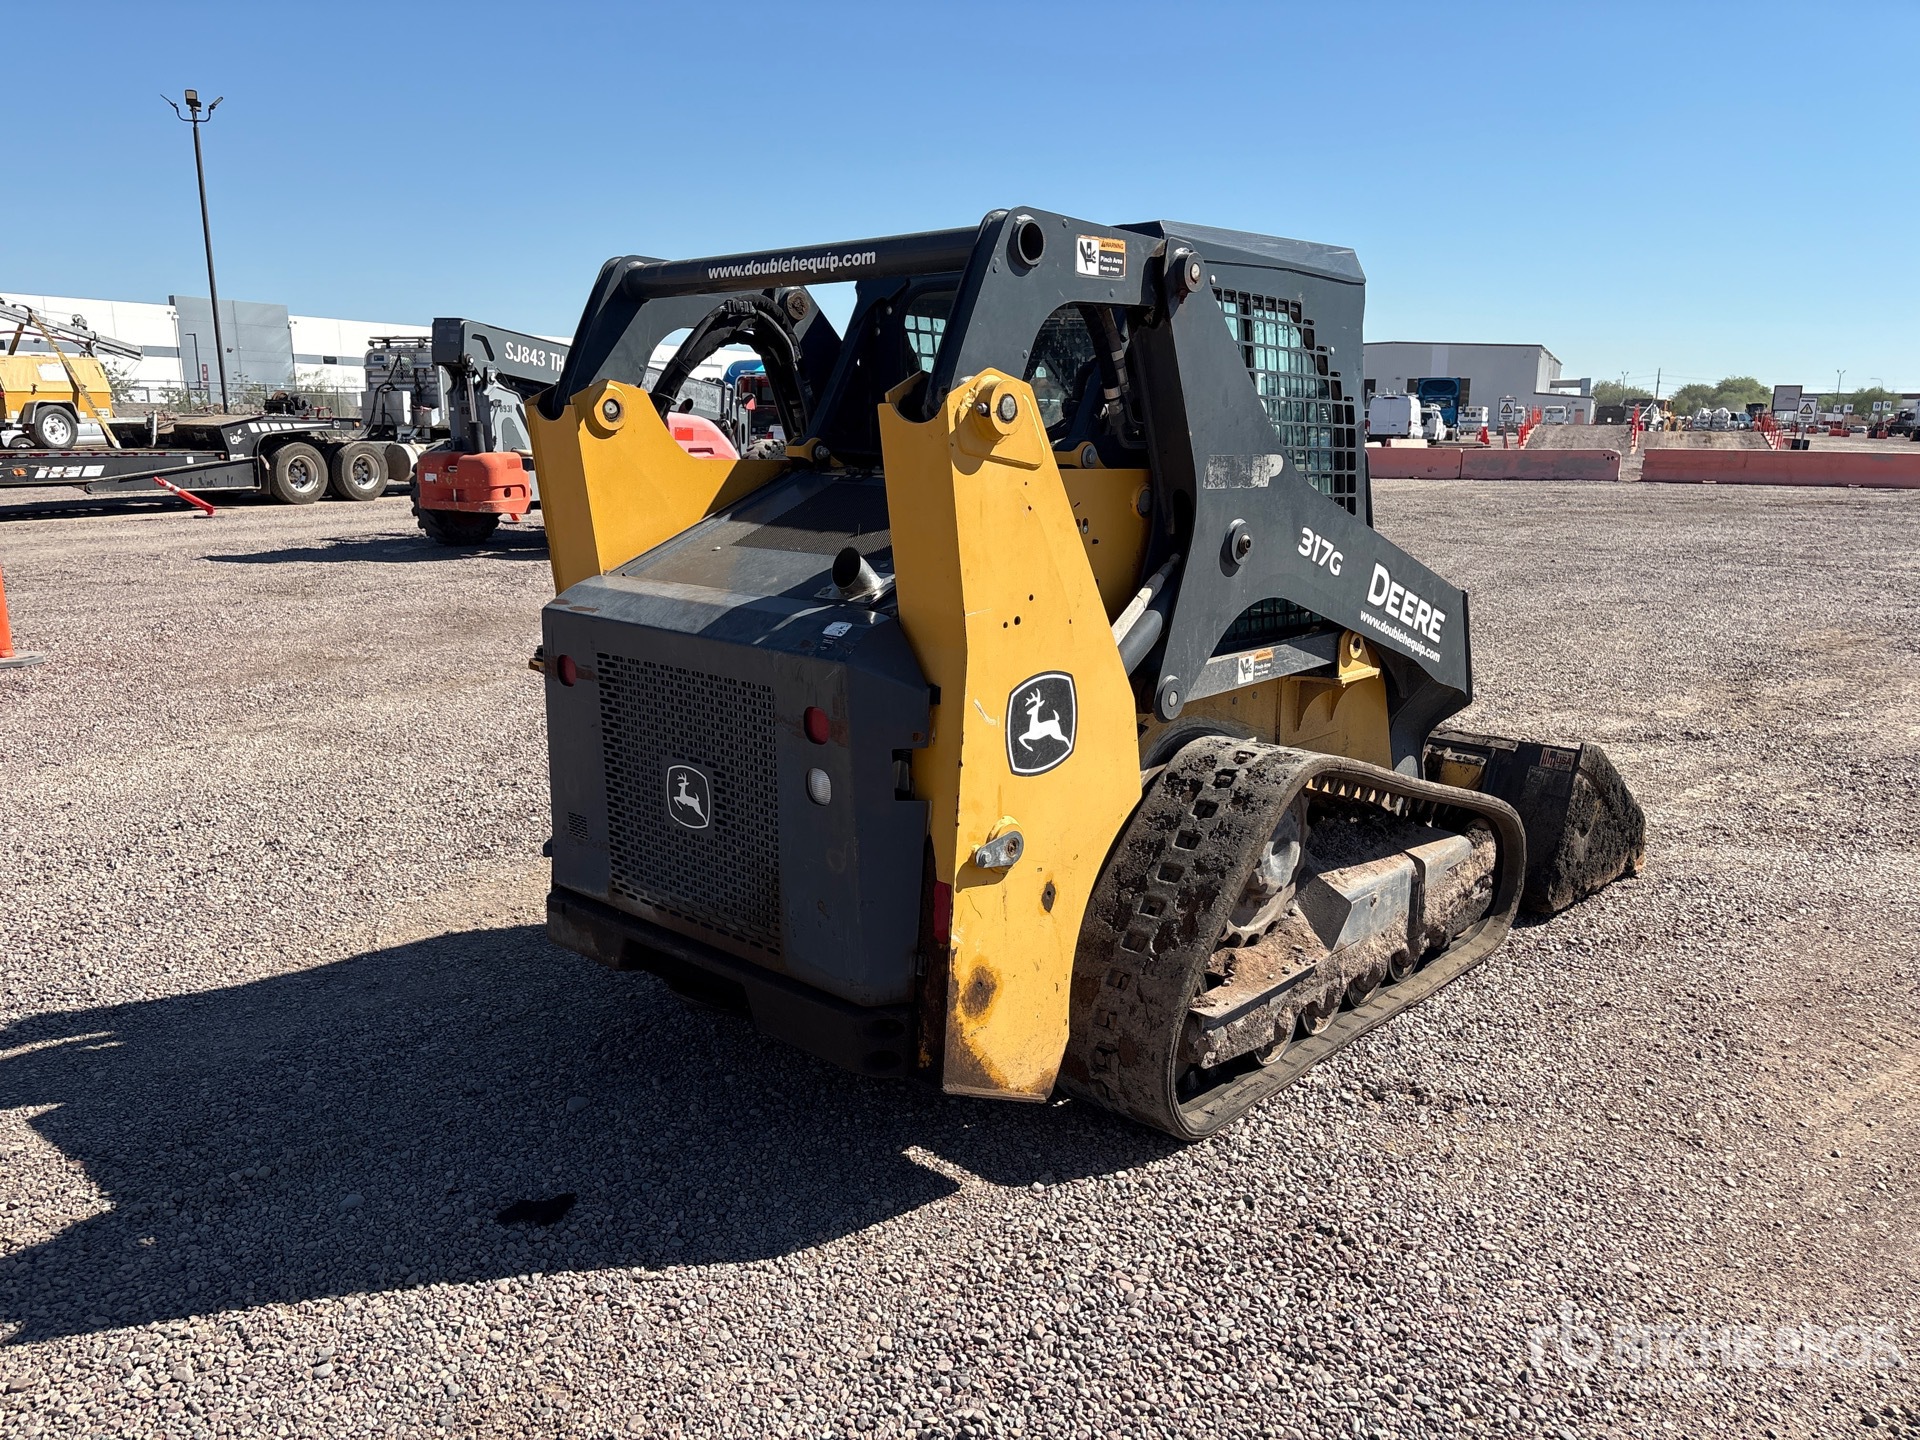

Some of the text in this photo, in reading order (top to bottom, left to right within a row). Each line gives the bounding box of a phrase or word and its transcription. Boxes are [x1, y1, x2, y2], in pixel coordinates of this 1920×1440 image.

[708, 251, 876, 279] www.doublehequip.com
[505, 341, 545, 366] SJ843
[1298, 527, 1344, 576] 317G
[1367, 562, 1446, 644] DEERE
[1360, 610, 1441, 663] www.doublehequip.com
[1556, 755, 1571, 765] USA
